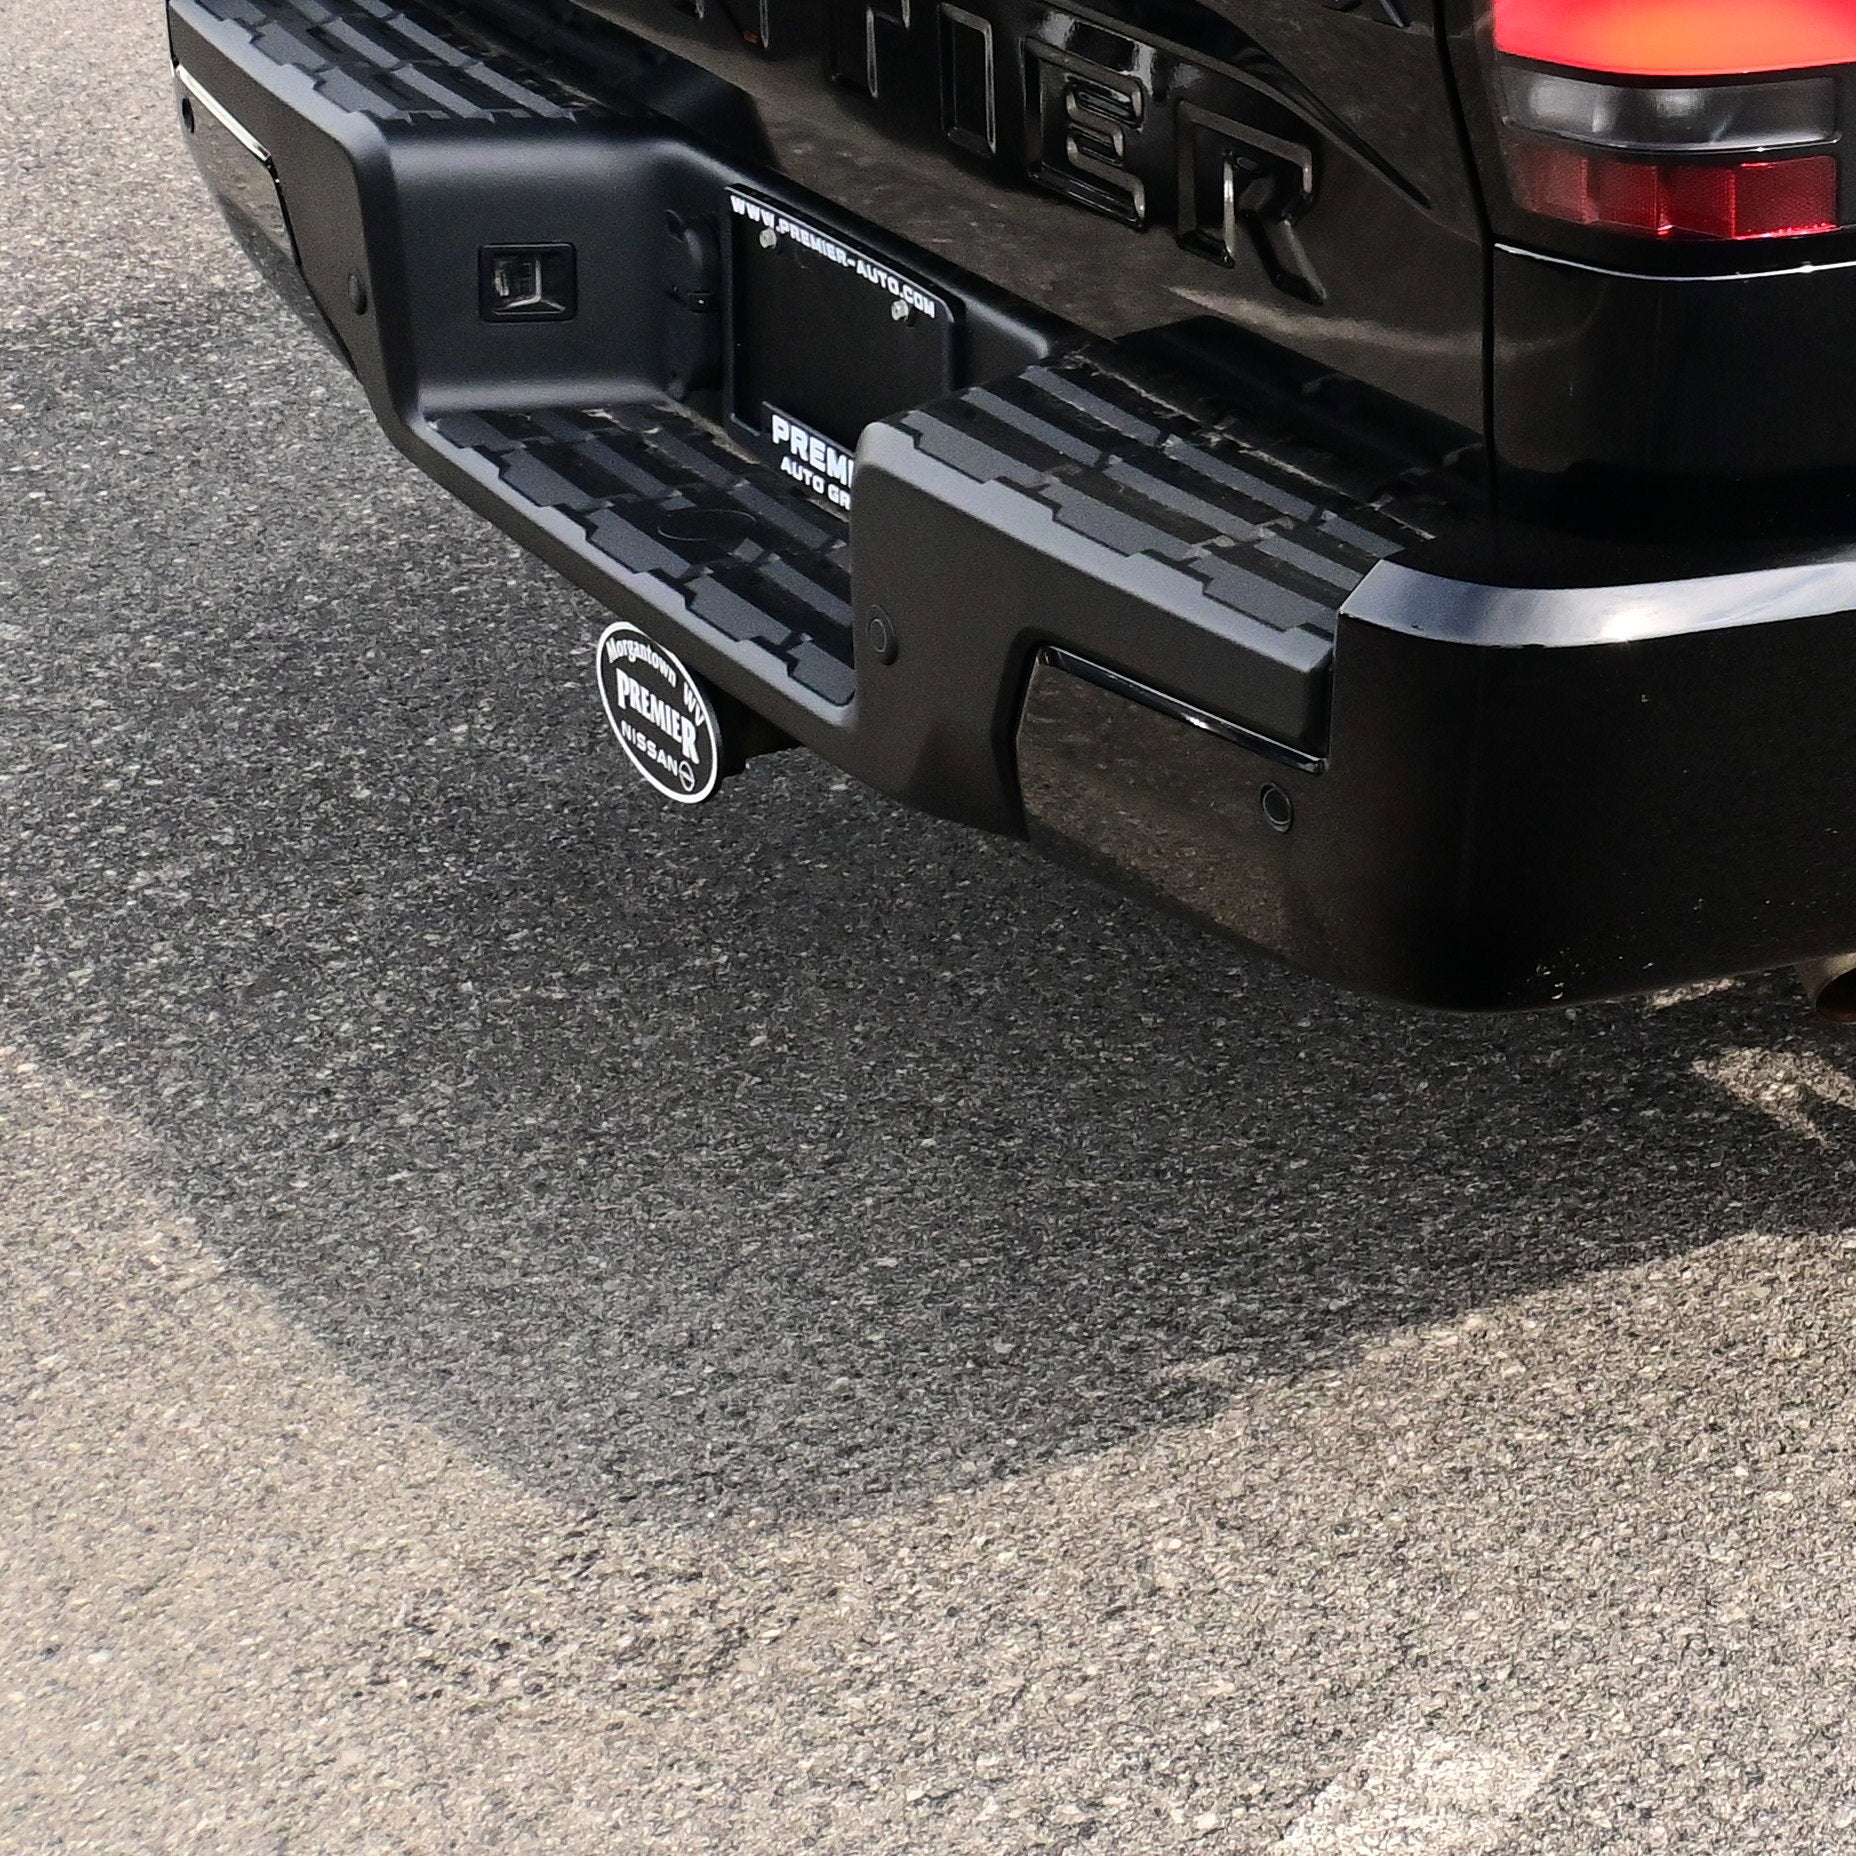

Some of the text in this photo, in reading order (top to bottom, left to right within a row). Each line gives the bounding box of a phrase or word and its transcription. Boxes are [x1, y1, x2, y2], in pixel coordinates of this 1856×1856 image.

[730, 195, 936, 319] WWW.PREMIER-AUTO.COM
[771, 414, 855, 489] PREMI
[780, 456, 826, 494] AUTO
[605, 637, 705, 727] Morgantown WV
[616, 667, 700, 765] PREMIER
[621, 719, 678, 777] NISSAN
